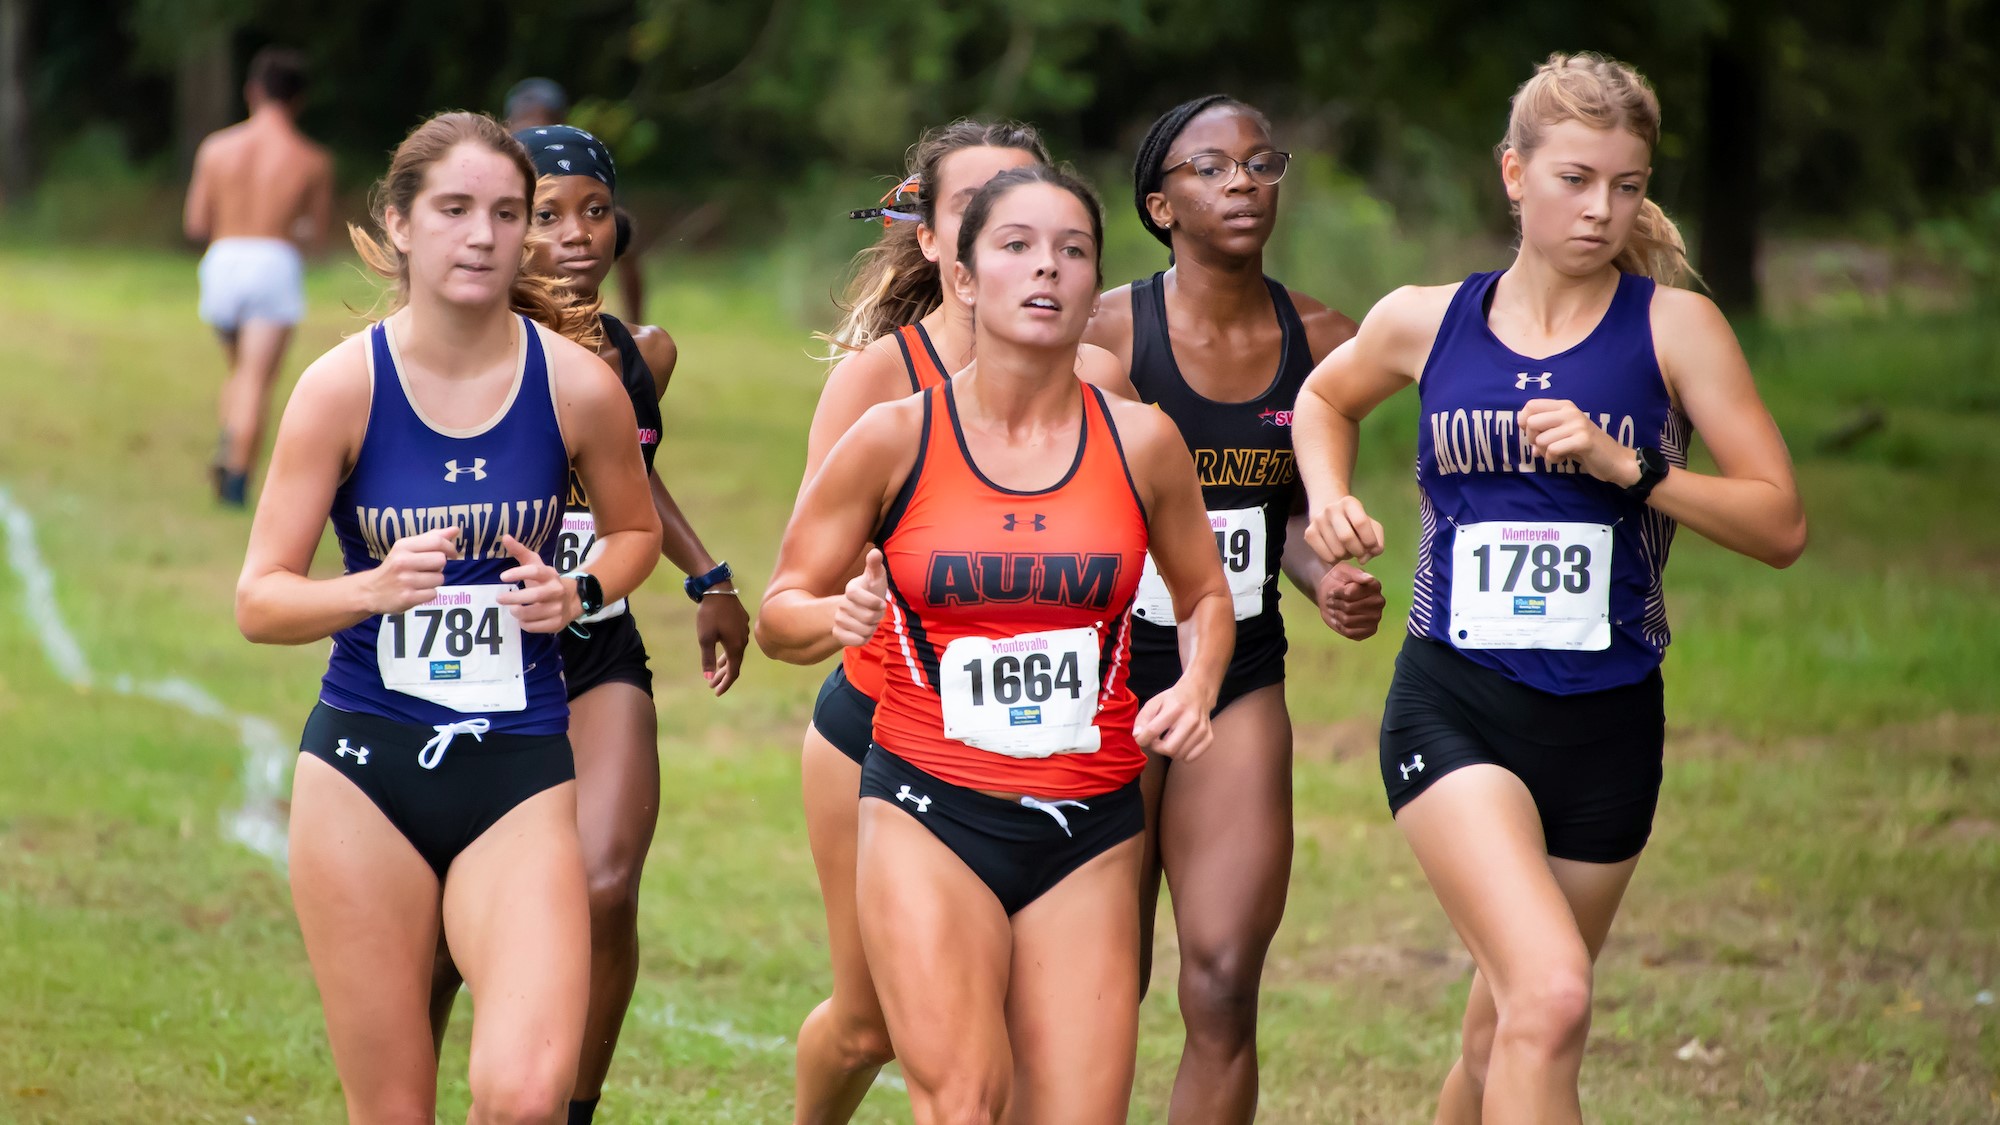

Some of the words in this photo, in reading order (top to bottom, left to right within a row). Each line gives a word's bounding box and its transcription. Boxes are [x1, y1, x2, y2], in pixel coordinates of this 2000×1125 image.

[1431, 408, 1634, 475] MONTEO
[1502, 527, 1560, 542] Montevallo
[923, 551, 1122, 612] AUM
[1473, 544, 1592, 594] 1783
[388, 607, 502, 659] 1784
[992, 637, 1048, 654] Montevallo
[963, 651, 1082, 706] 1664
